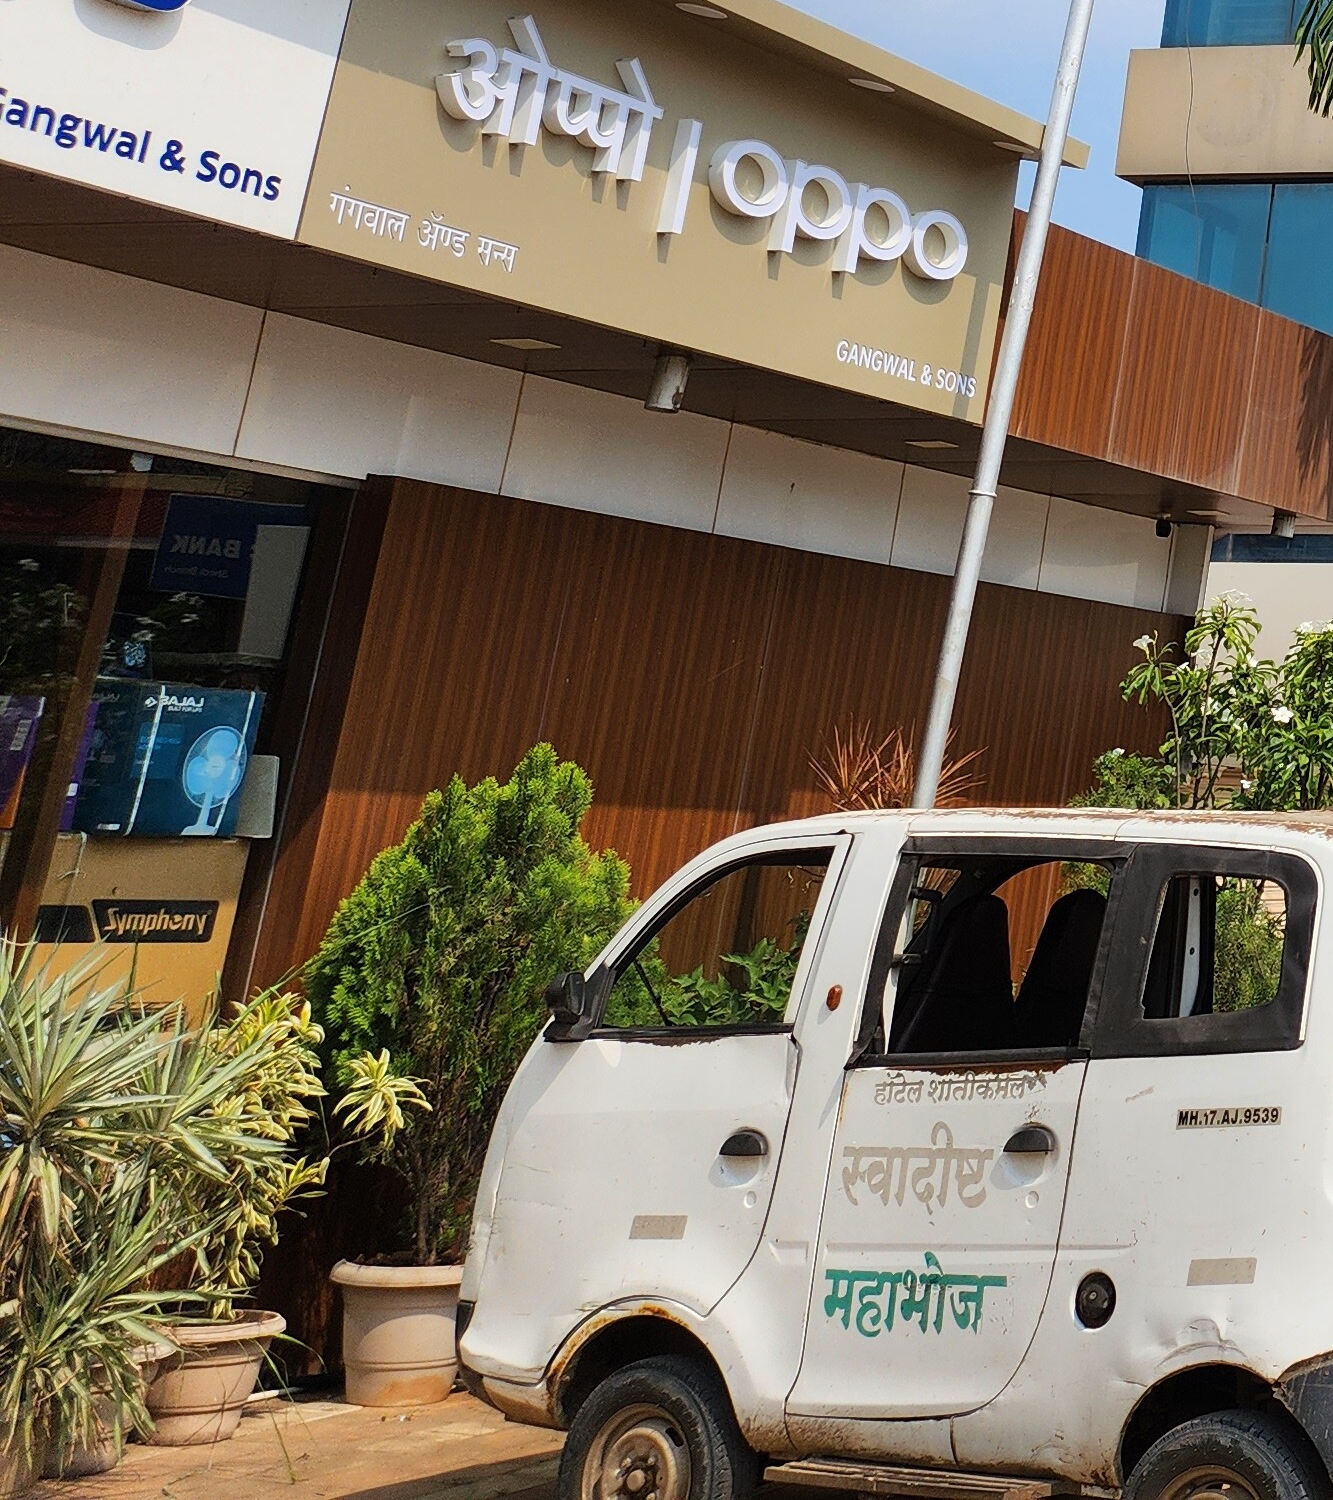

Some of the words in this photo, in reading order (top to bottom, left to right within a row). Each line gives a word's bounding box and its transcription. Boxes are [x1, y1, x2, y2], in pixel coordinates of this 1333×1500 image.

[436, 14, 664, 181] ओप्पो
[160, 139, 186, 175] &
[196, 150, 282, 201] Sons
[330, 185, 411, 243] गंगवाल
[477, 235, 521, 273] सन्स
[708, 139, 968, 279] oppo
[836, 339, 918, 382] GANGWAL
[920, 363, 933, 386] &
[935, 367, 977, 398] SONS
[160, 695, 205, 708] BAJAJ
[103, 907, 210, 935] Symphony
[1178, 1107, 1279, 1126] MH.17.AJ.9539
[824, 1251, 1007, 1338] महाभोज
